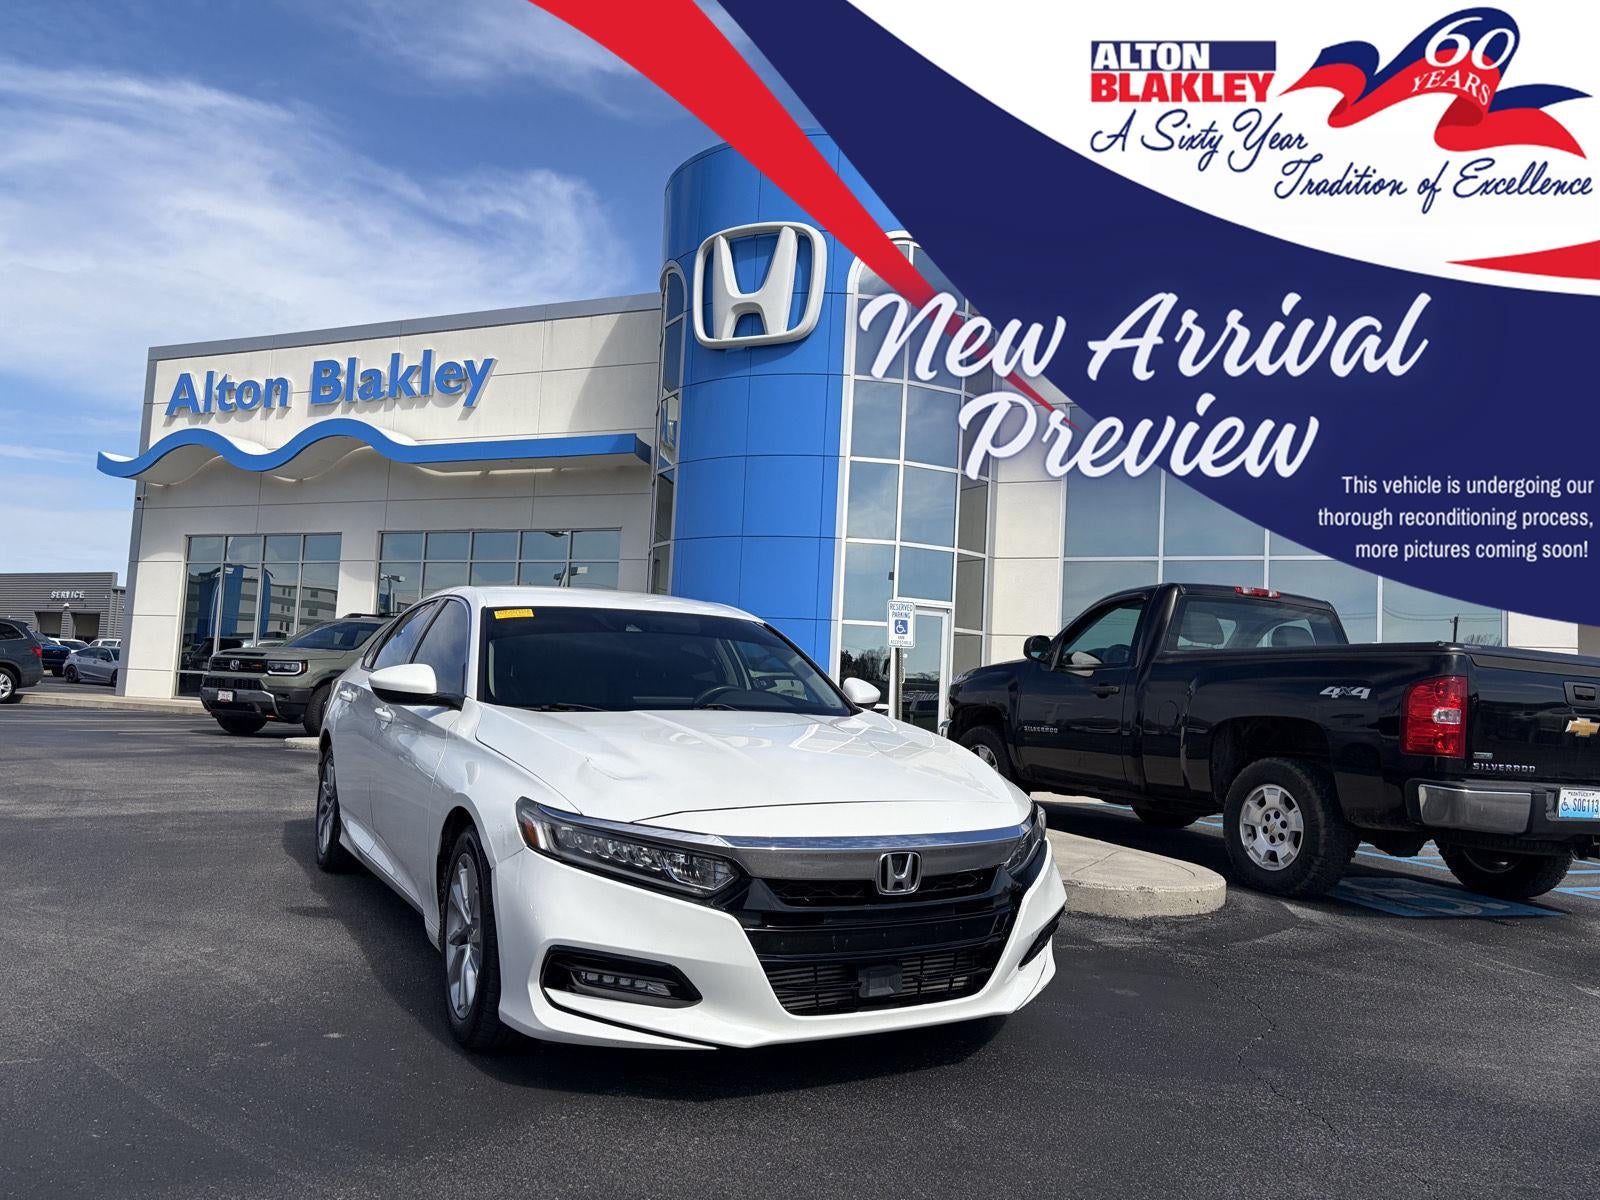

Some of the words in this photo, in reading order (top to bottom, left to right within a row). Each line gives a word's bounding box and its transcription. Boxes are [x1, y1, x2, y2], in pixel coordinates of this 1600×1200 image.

[165, 370, 289, 416] Alton
[310, 348, 496, 408] Blakley
[50, 590, 85, 599] SERVICE
[889, 603, 913, 612] RESERVED
[891, 611, 911, 619] PARKING
[1472, 762, 1536, 773] SILVERADO
